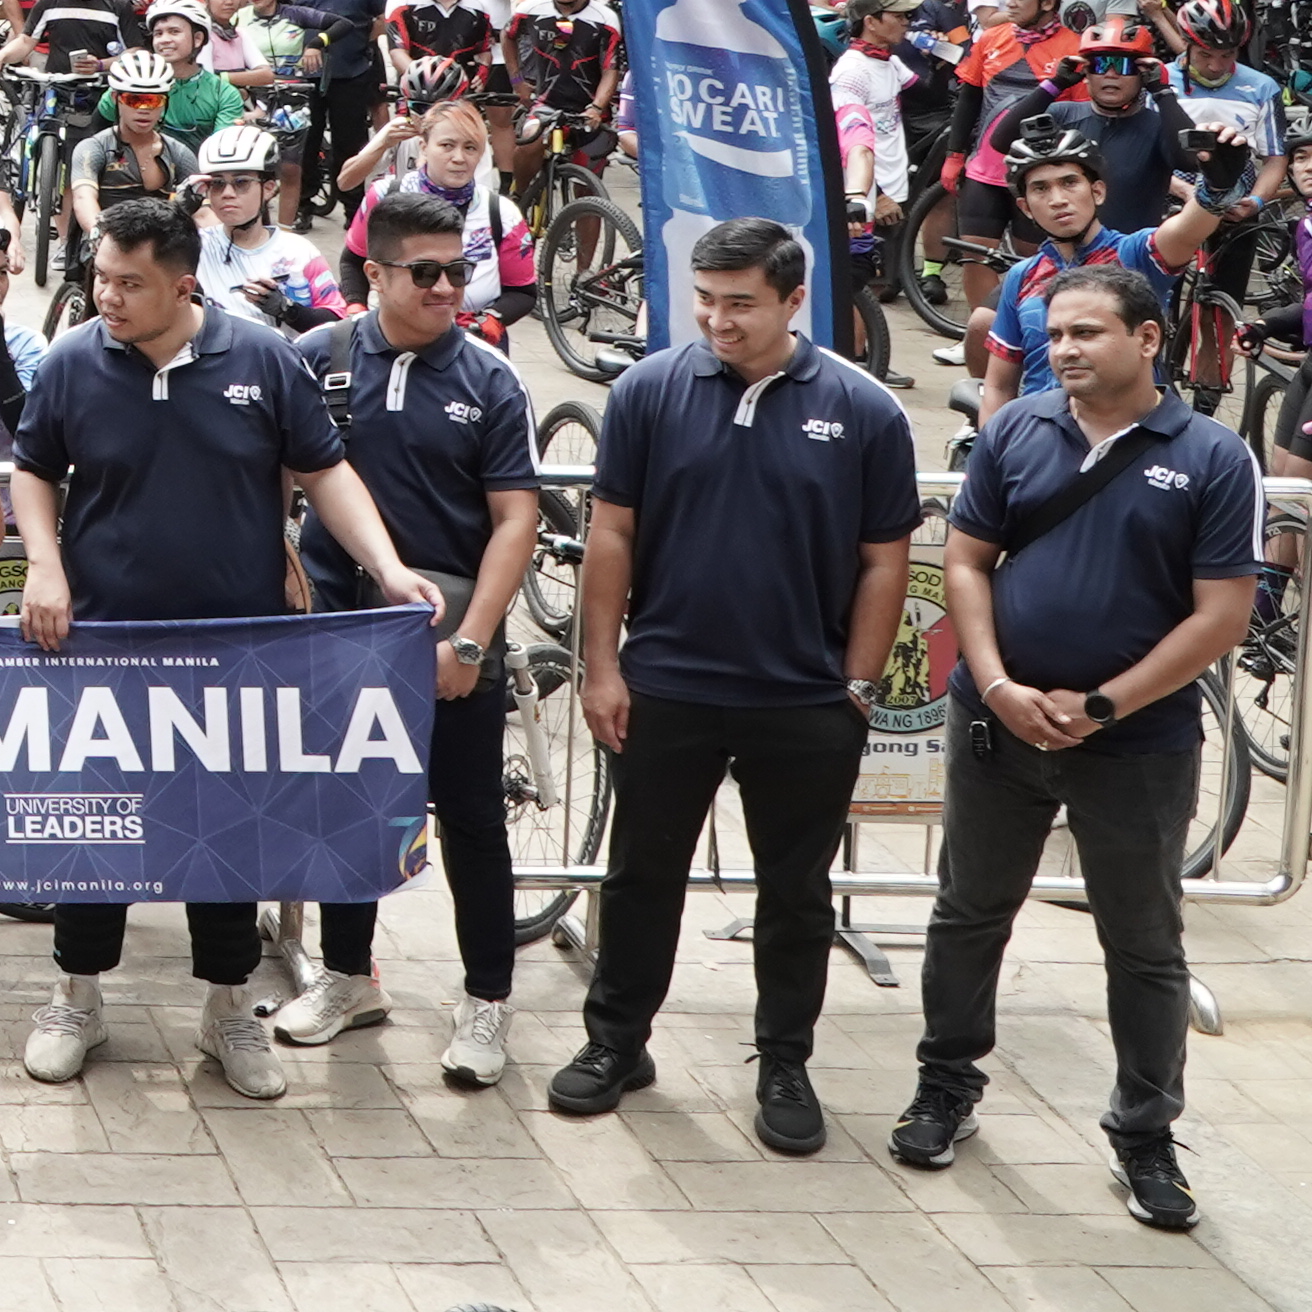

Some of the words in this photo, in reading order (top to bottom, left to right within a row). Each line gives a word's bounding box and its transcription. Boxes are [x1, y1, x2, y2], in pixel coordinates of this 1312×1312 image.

[223, 384, 250, 399] JCI
[444, 401, 471, 418] JCI
[802, 419, 831, 435] JCI
[1144, 465, 1176, 484] JCI
[45, 657, 158, 668] INTERNATIONAL
[163, 657, 220, 668] MANILA
[885, 694, 918, 706] 2007
[892, 712, 914, 728] NG
[5, 798, 113, 815] UNIVERSITY
[116, 798, 143, 815] OF
[7, 816, 144, 839] LEADERS
